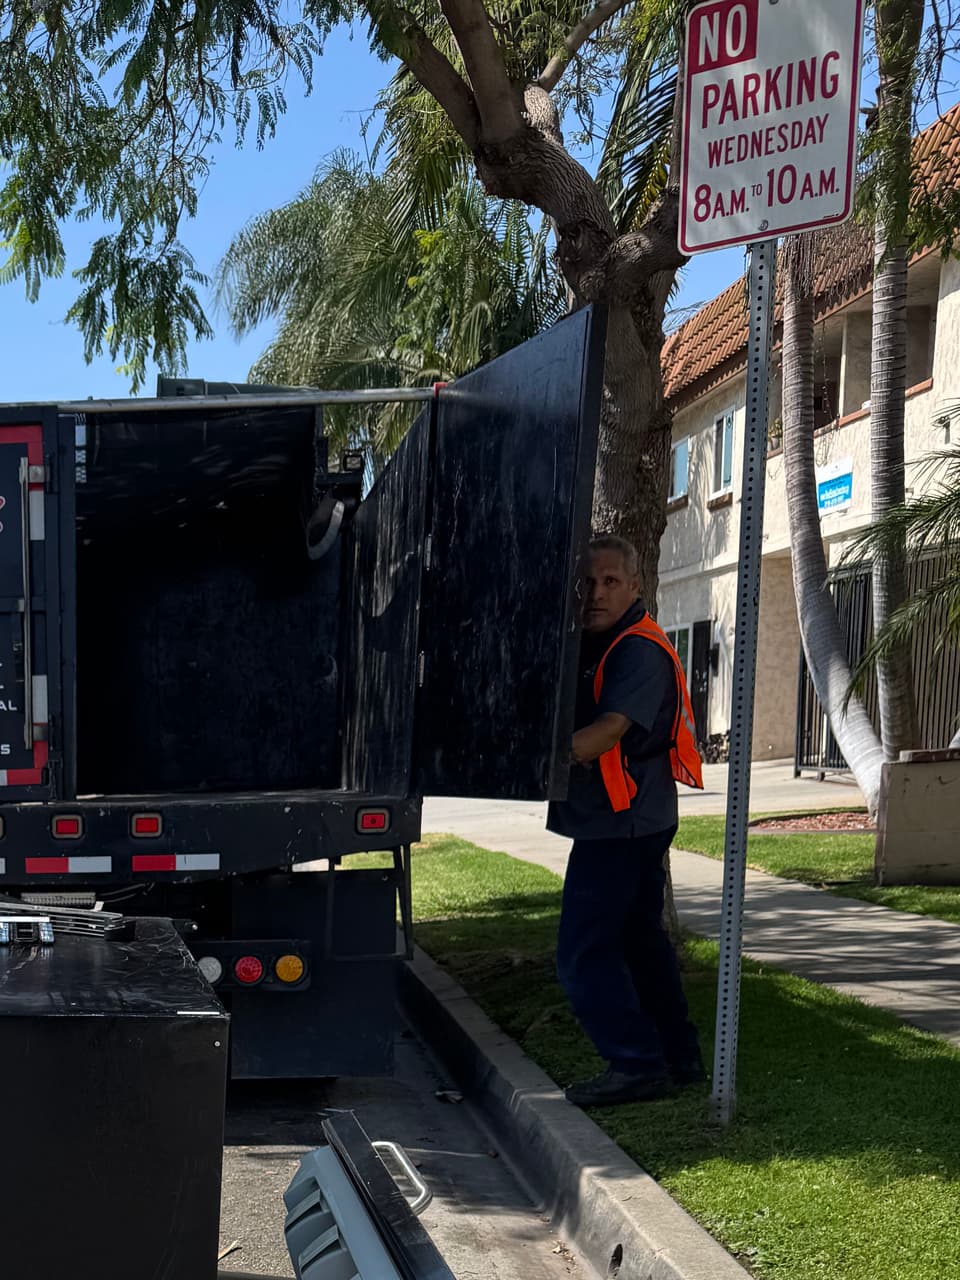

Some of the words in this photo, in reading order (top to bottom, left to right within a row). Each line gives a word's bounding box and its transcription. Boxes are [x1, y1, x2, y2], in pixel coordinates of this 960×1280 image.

[698, 4, 747, 66] NO
[702, 50, 840, 129] PARKING
[708, 113, 829, 168] WEDNESDAY
[751, 184, 762, 197] TO
